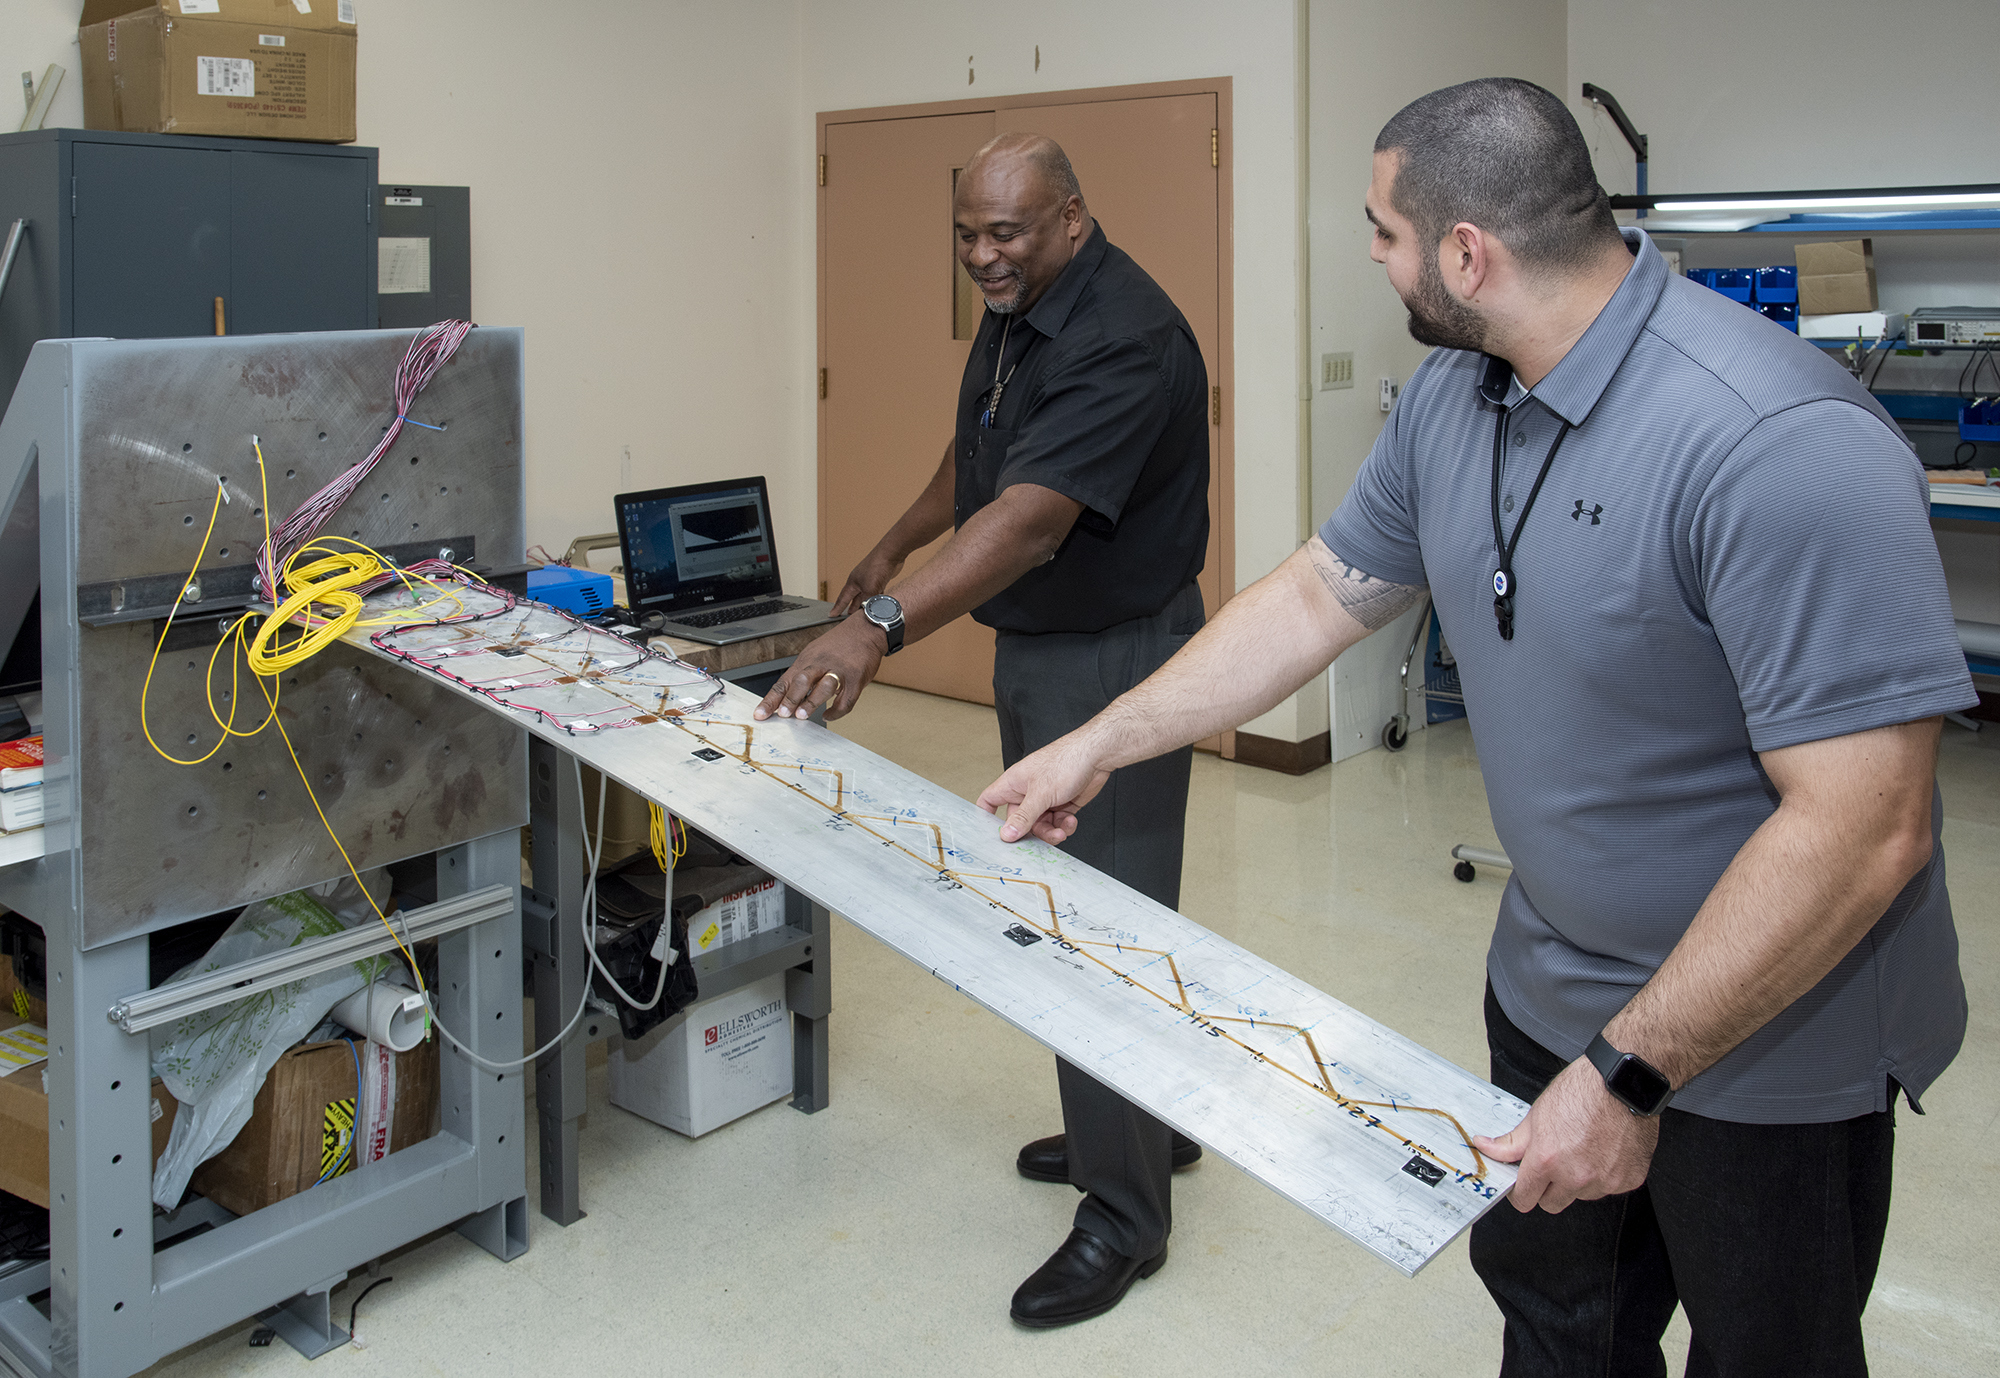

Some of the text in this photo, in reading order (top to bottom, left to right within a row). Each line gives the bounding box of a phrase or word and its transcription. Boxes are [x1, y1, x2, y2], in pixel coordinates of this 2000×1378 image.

[883, 806, 918, 818] 218
[986, 863, 1023, 877] 201
[719, 999, 781, 1035] ELLSWORTH
[1190, 1015, 1227, 1037] 115
[719, 1021, 754, 1040] ADHESIVES
[331, 1107, 351, 1129] HEAVY
